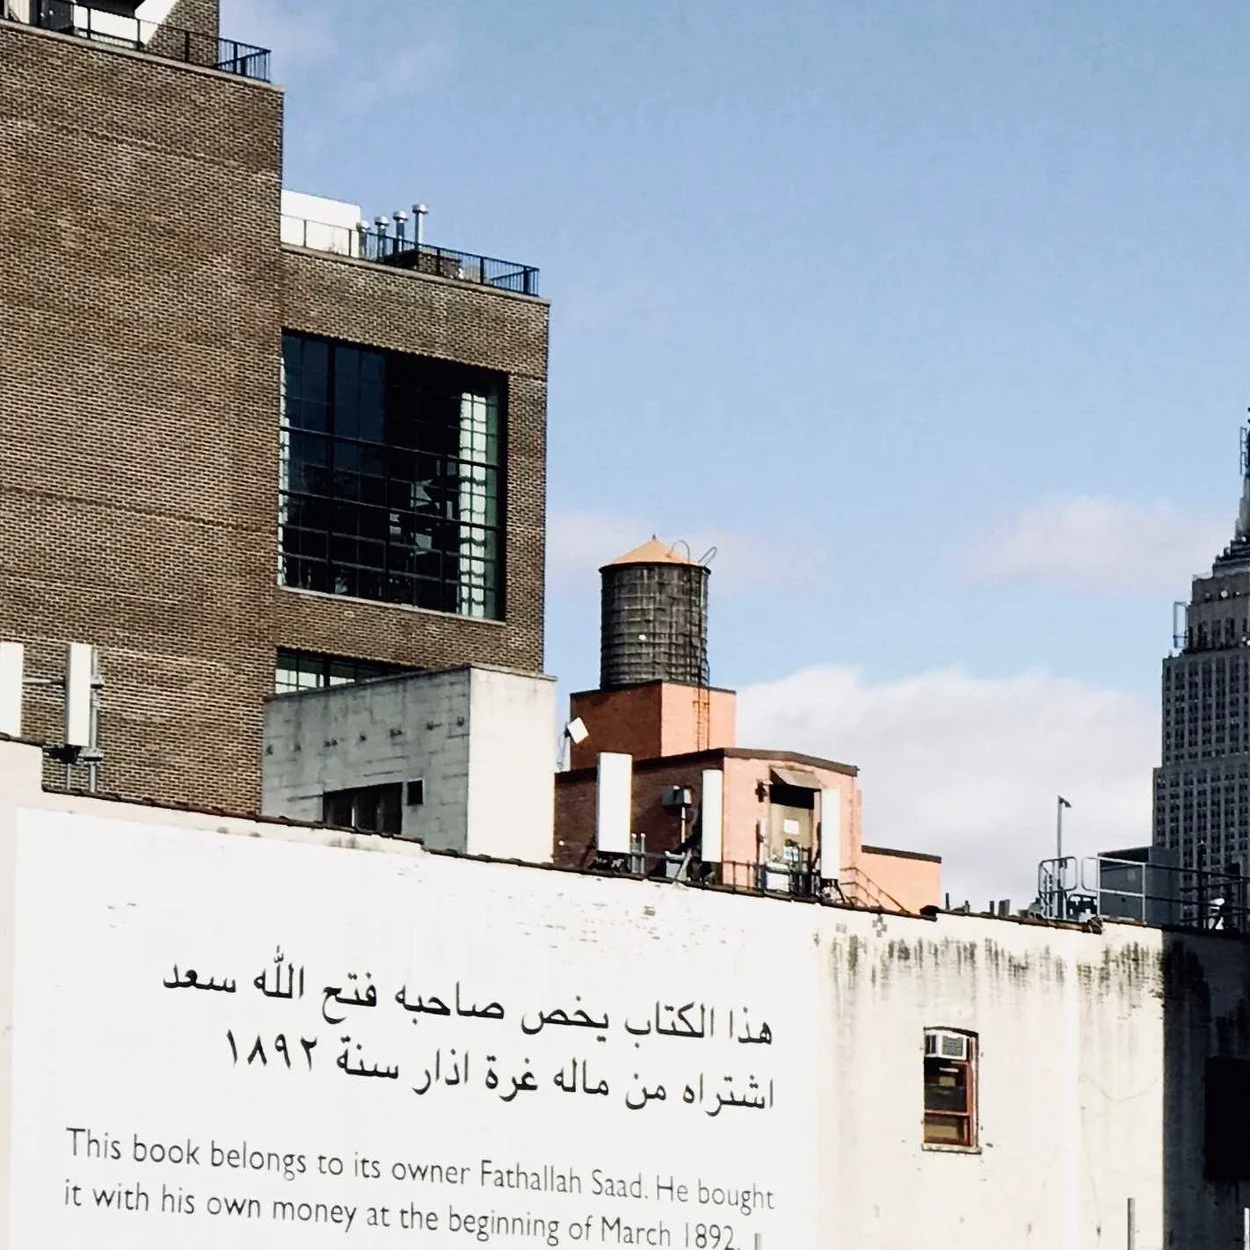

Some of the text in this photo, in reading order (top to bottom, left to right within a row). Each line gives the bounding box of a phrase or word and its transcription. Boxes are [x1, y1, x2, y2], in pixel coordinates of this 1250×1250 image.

[163, 946, 772, 1048] هذا الكتاب يخص صاحبه فتح الله سعد
[227, 1030, 773, 1117] اشتراه من ماله غرة اذار سنة ١٨٩٢
[65, 1178, 82, 1207] it
[94, 1183, 148, 1210] with
[162, 1186, 194, 1214] his
[208, 1197, 260, 1217] own
[273, 1202, 356, 1232] money
[367, 1208, 390, 1230] at
[400, 1203, 438, 1230] the
[450, 1206, 559, 1246] beginning
[568, 1213, 593, 1240] of
[602, 1217, 669, 1245] March
[67, 1128, 774, 1216] This book belongs to its owner Fathallah Saad. He bought
